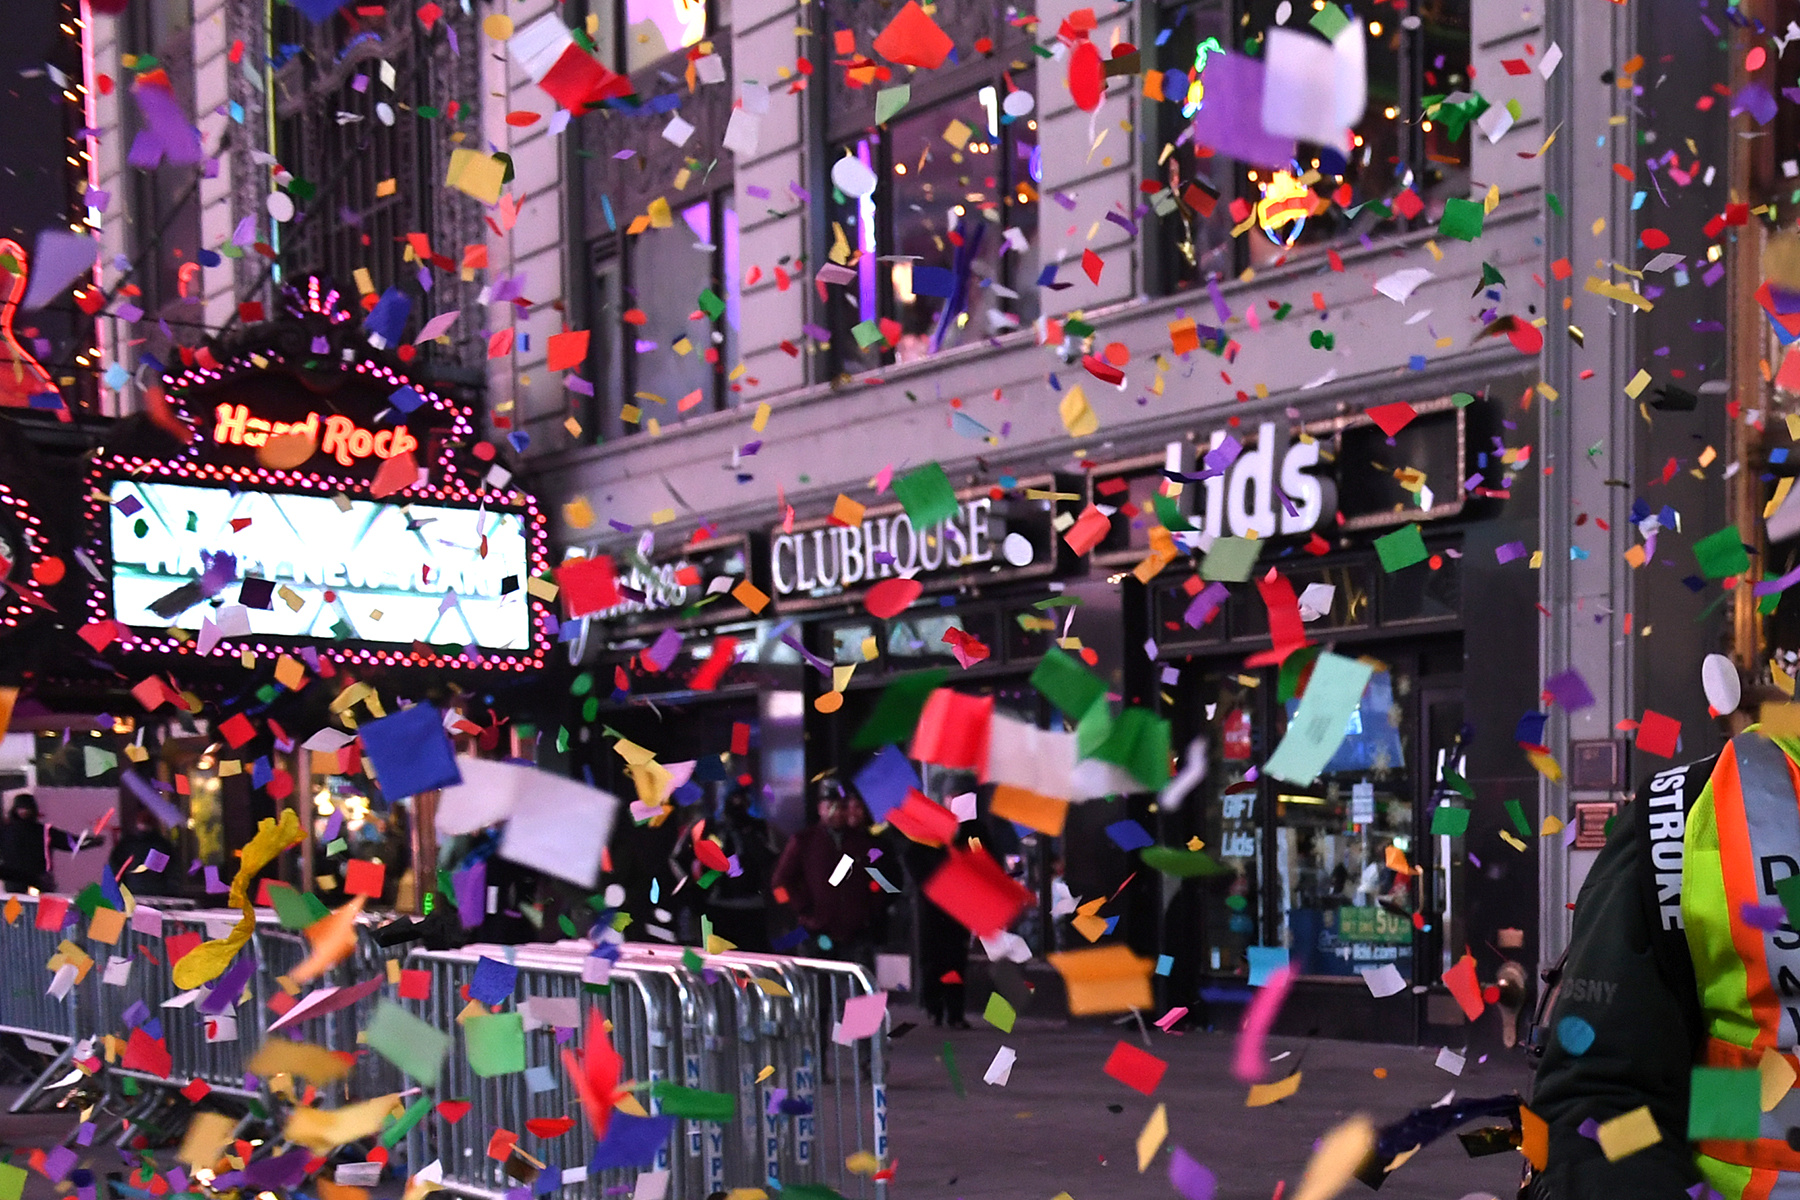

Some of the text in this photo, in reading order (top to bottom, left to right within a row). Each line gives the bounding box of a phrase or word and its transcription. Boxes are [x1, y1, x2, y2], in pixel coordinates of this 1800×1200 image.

[214, 402, 418, 466] Hard Rock
[771, 497, 994, 595] CLUBHOUSE
